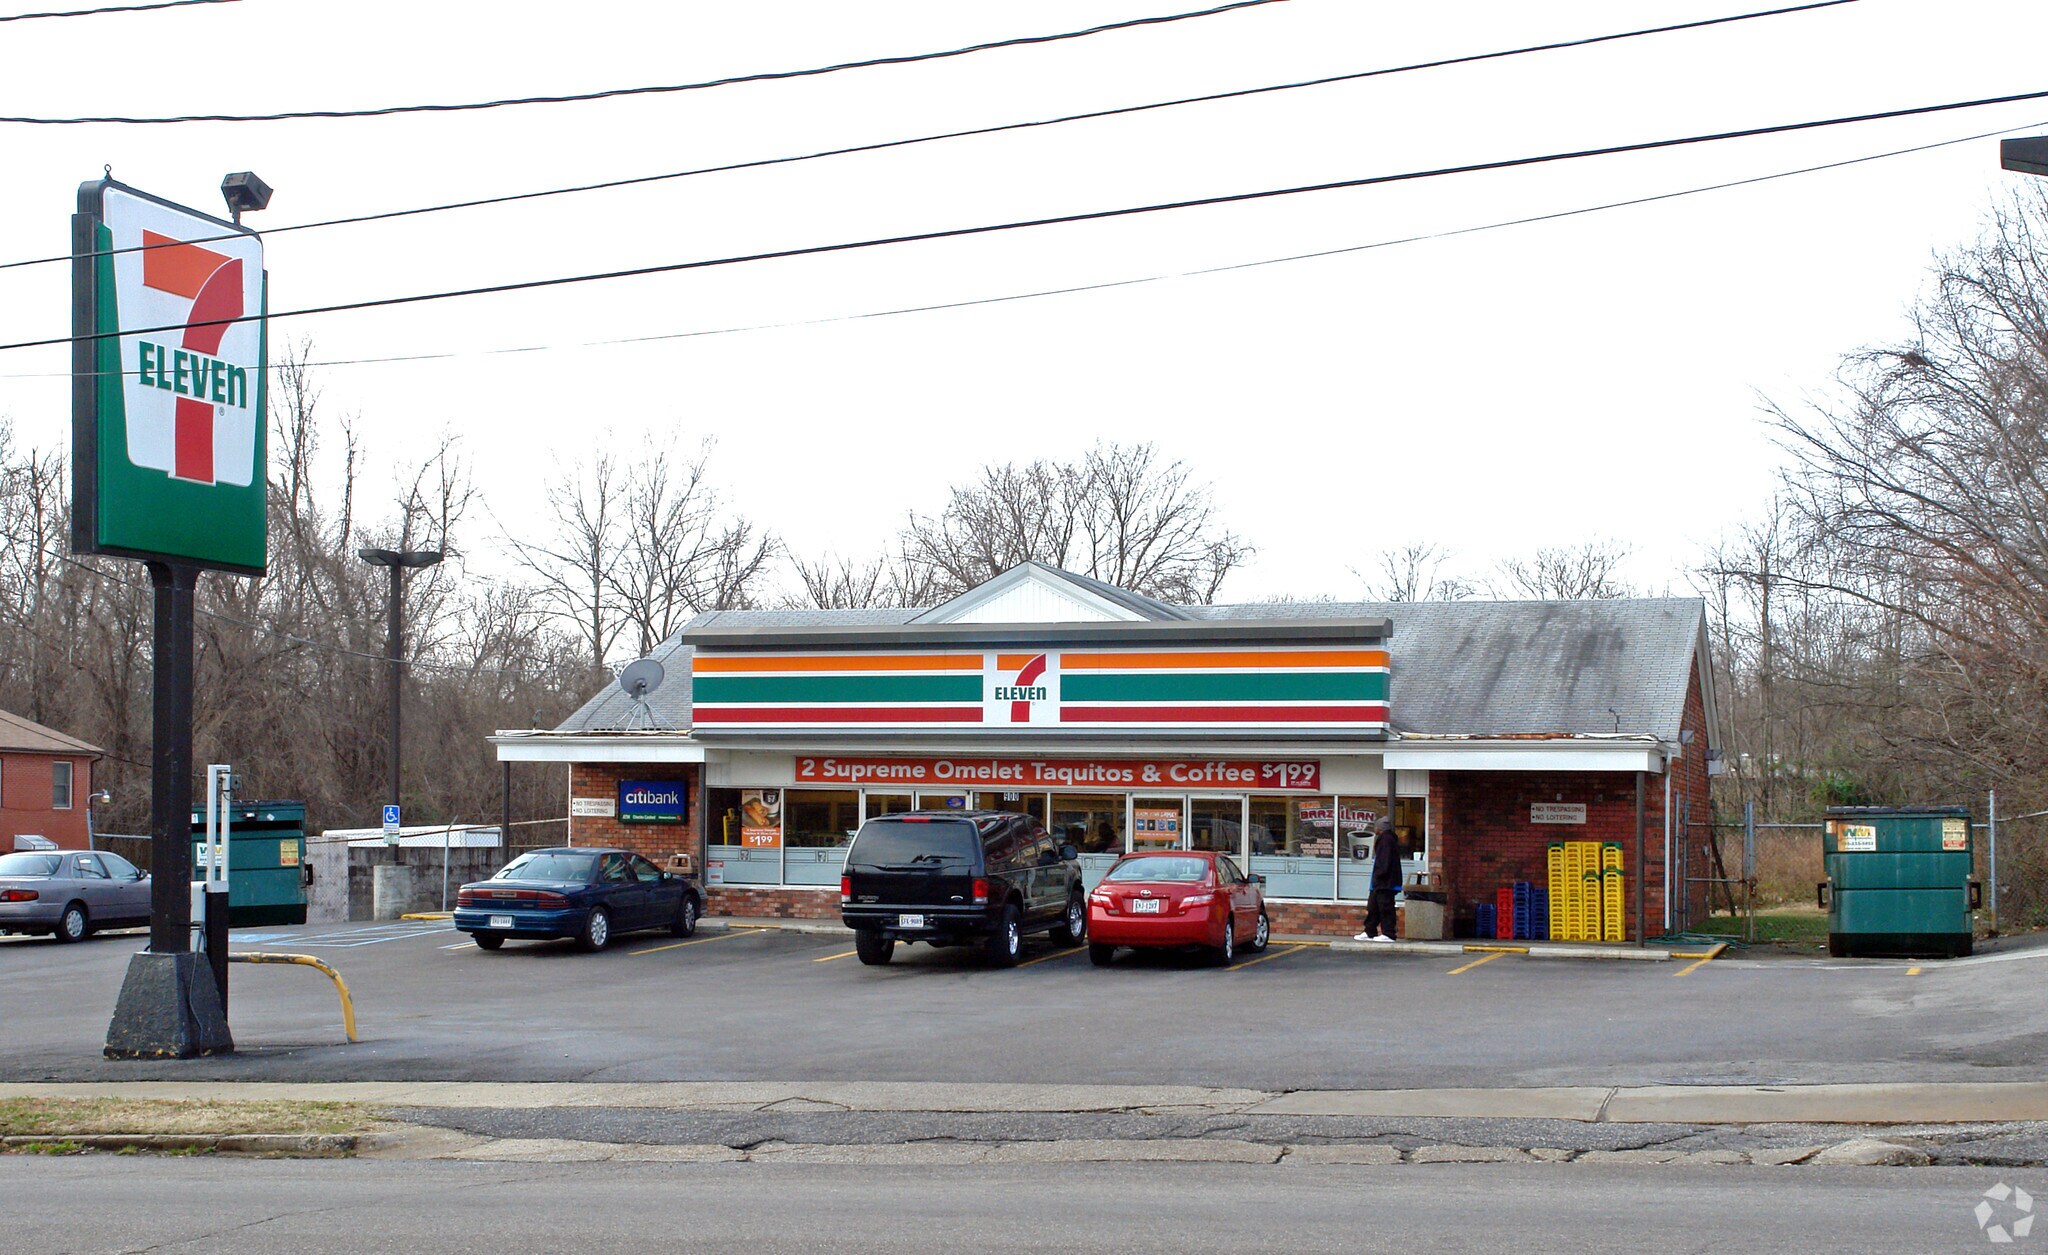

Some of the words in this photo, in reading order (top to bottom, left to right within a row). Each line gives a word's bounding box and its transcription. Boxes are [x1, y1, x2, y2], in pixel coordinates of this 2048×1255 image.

[142, 228, 245, 484] 7
[996, 653, 1047, 723] 7
[801, 759, 816, 777] 2
[823, 759, 926, 782] Supreme
[934, 760, 1023, 780] Omelet
[1031, 762, 1134, 785] Taquitos
[1141, 763, 1162, 783] &
[1169, 761, 1256, 782] Coffee
[625, 788, 679, 804] citibank
[1004, 792, 1019, 801] 900
